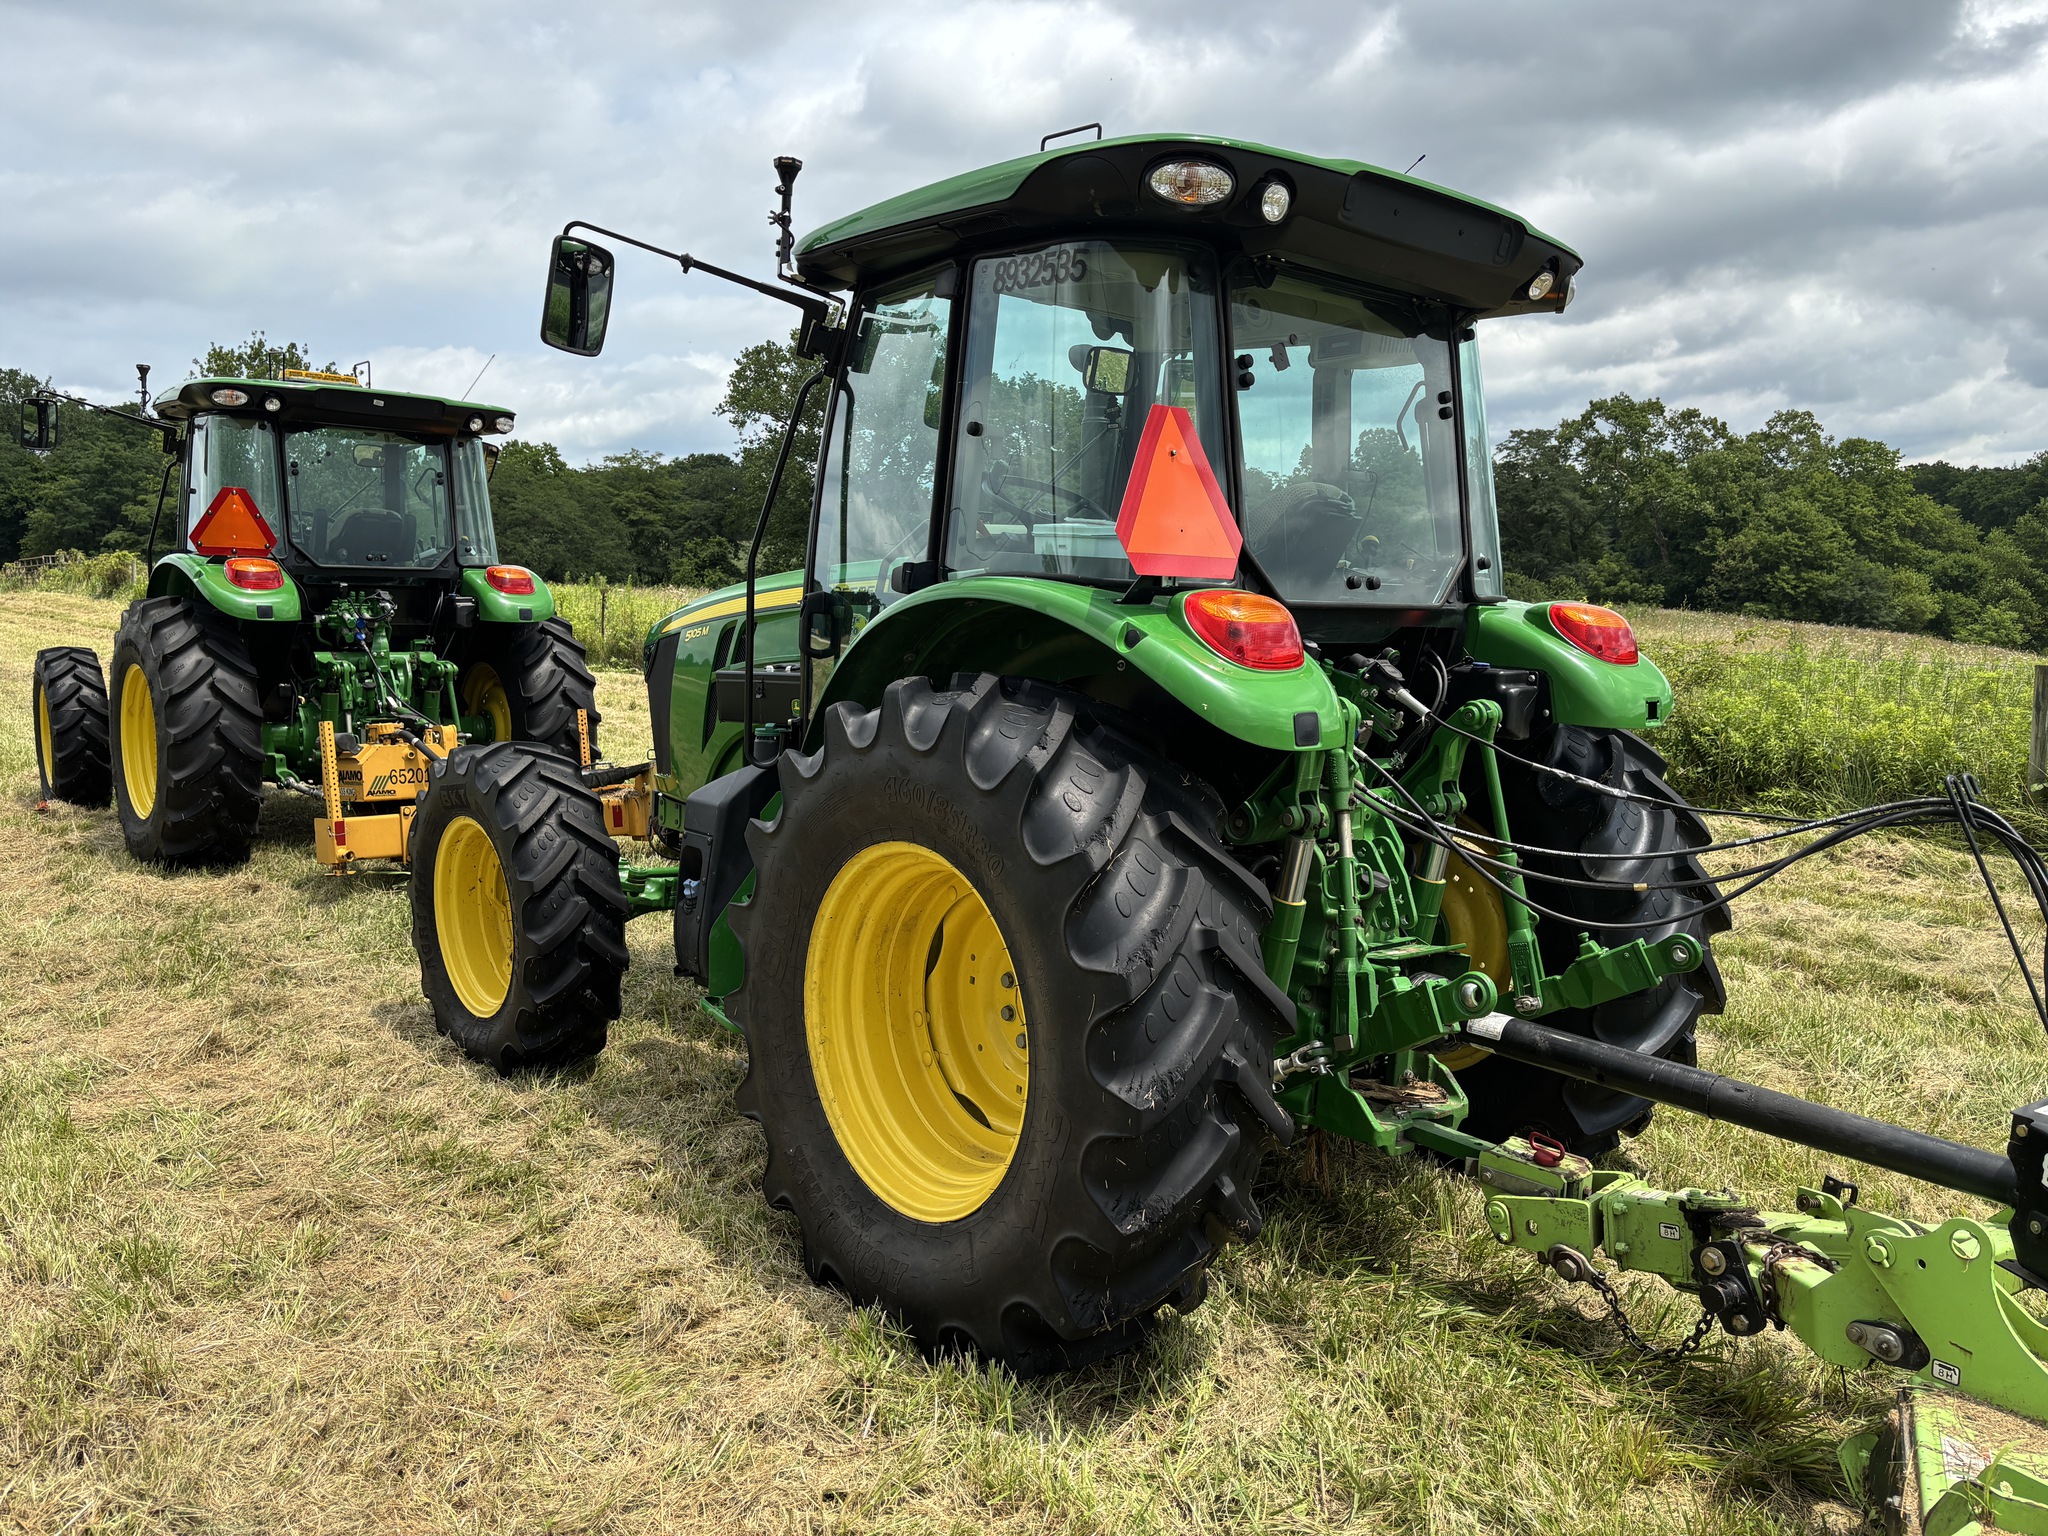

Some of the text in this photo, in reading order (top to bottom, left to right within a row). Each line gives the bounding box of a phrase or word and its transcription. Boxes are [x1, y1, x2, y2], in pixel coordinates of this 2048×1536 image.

[993, 248, 1090, 294] 8932535
[390, 769, 429, 785] 65201
[366, 789, 396, 797] ALAMO
[442, 789, 469, 808] BKT
